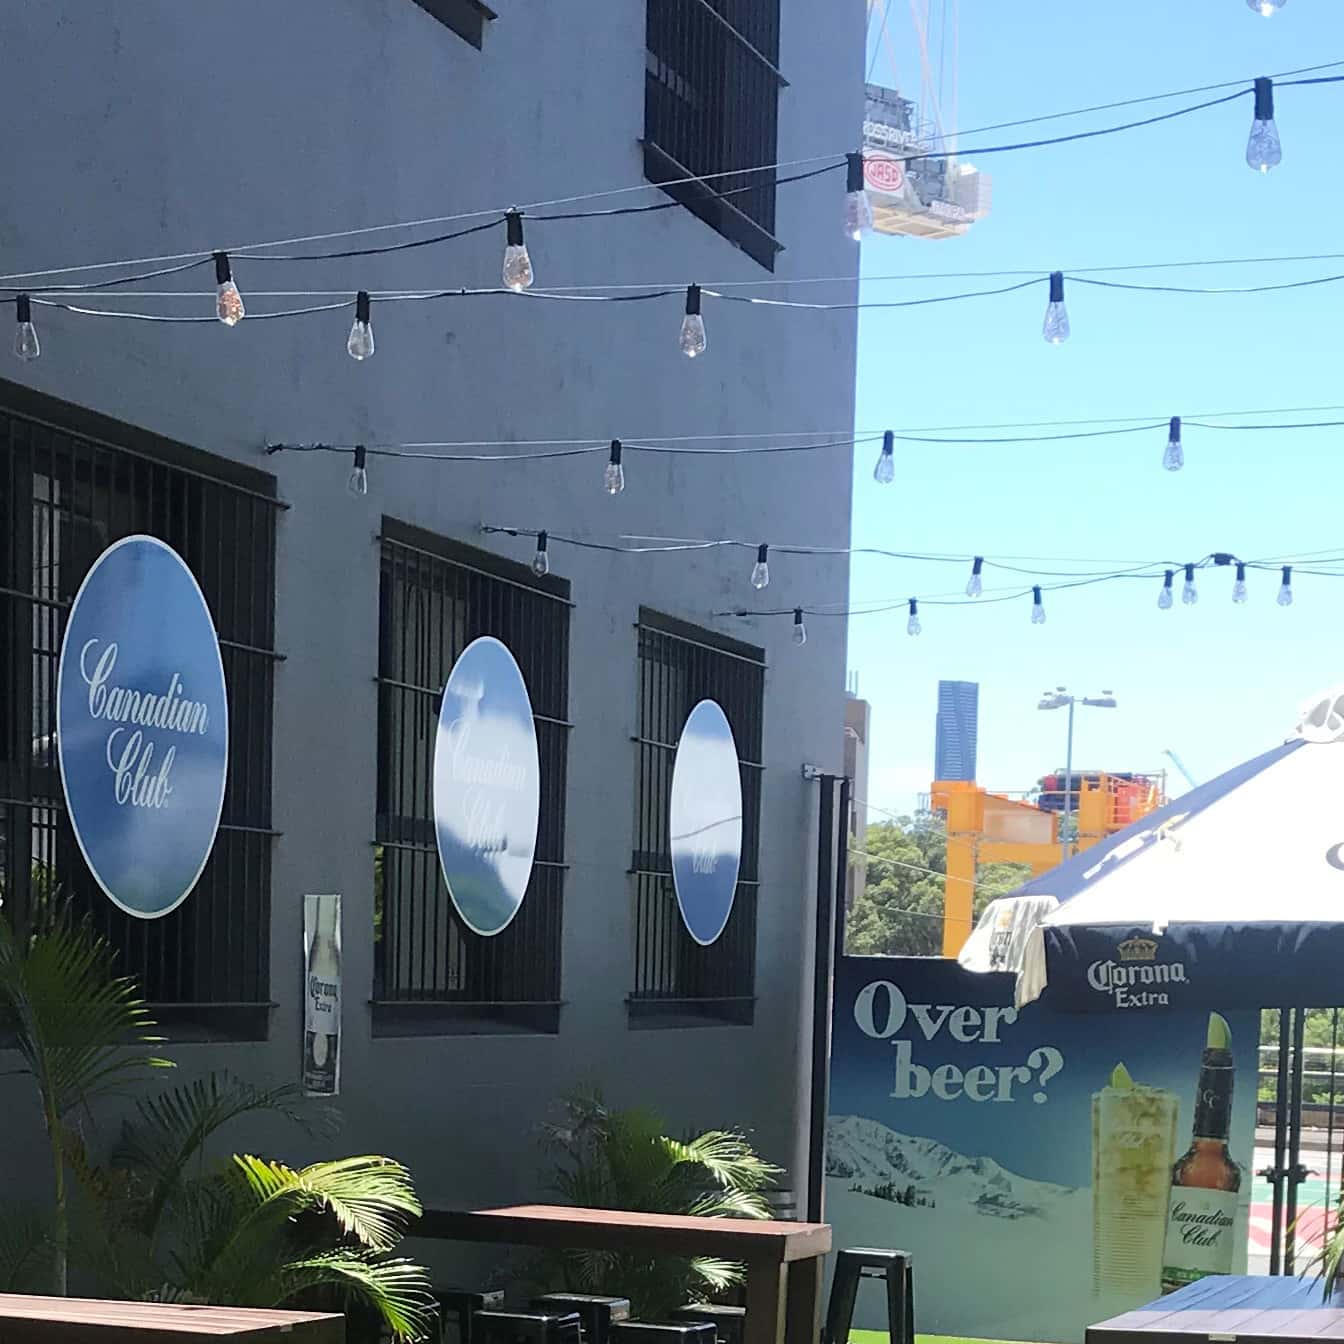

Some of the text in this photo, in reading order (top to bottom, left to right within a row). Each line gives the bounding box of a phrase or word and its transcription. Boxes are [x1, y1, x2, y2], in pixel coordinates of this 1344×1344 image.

[80, 638, 209, 735] Canadian
[106, 727, 177, 809] Club
[1087, 959, 1186, 992] Corona
[1114, 987, 1169, 1009] Extra
[854, 980, 1017, 1043] Over
[889, 1040, 1064, 1104] beer?
[1171, 1201, 1234, 1227] Canadian
[1180, 1224, 1221, 1247] Club
